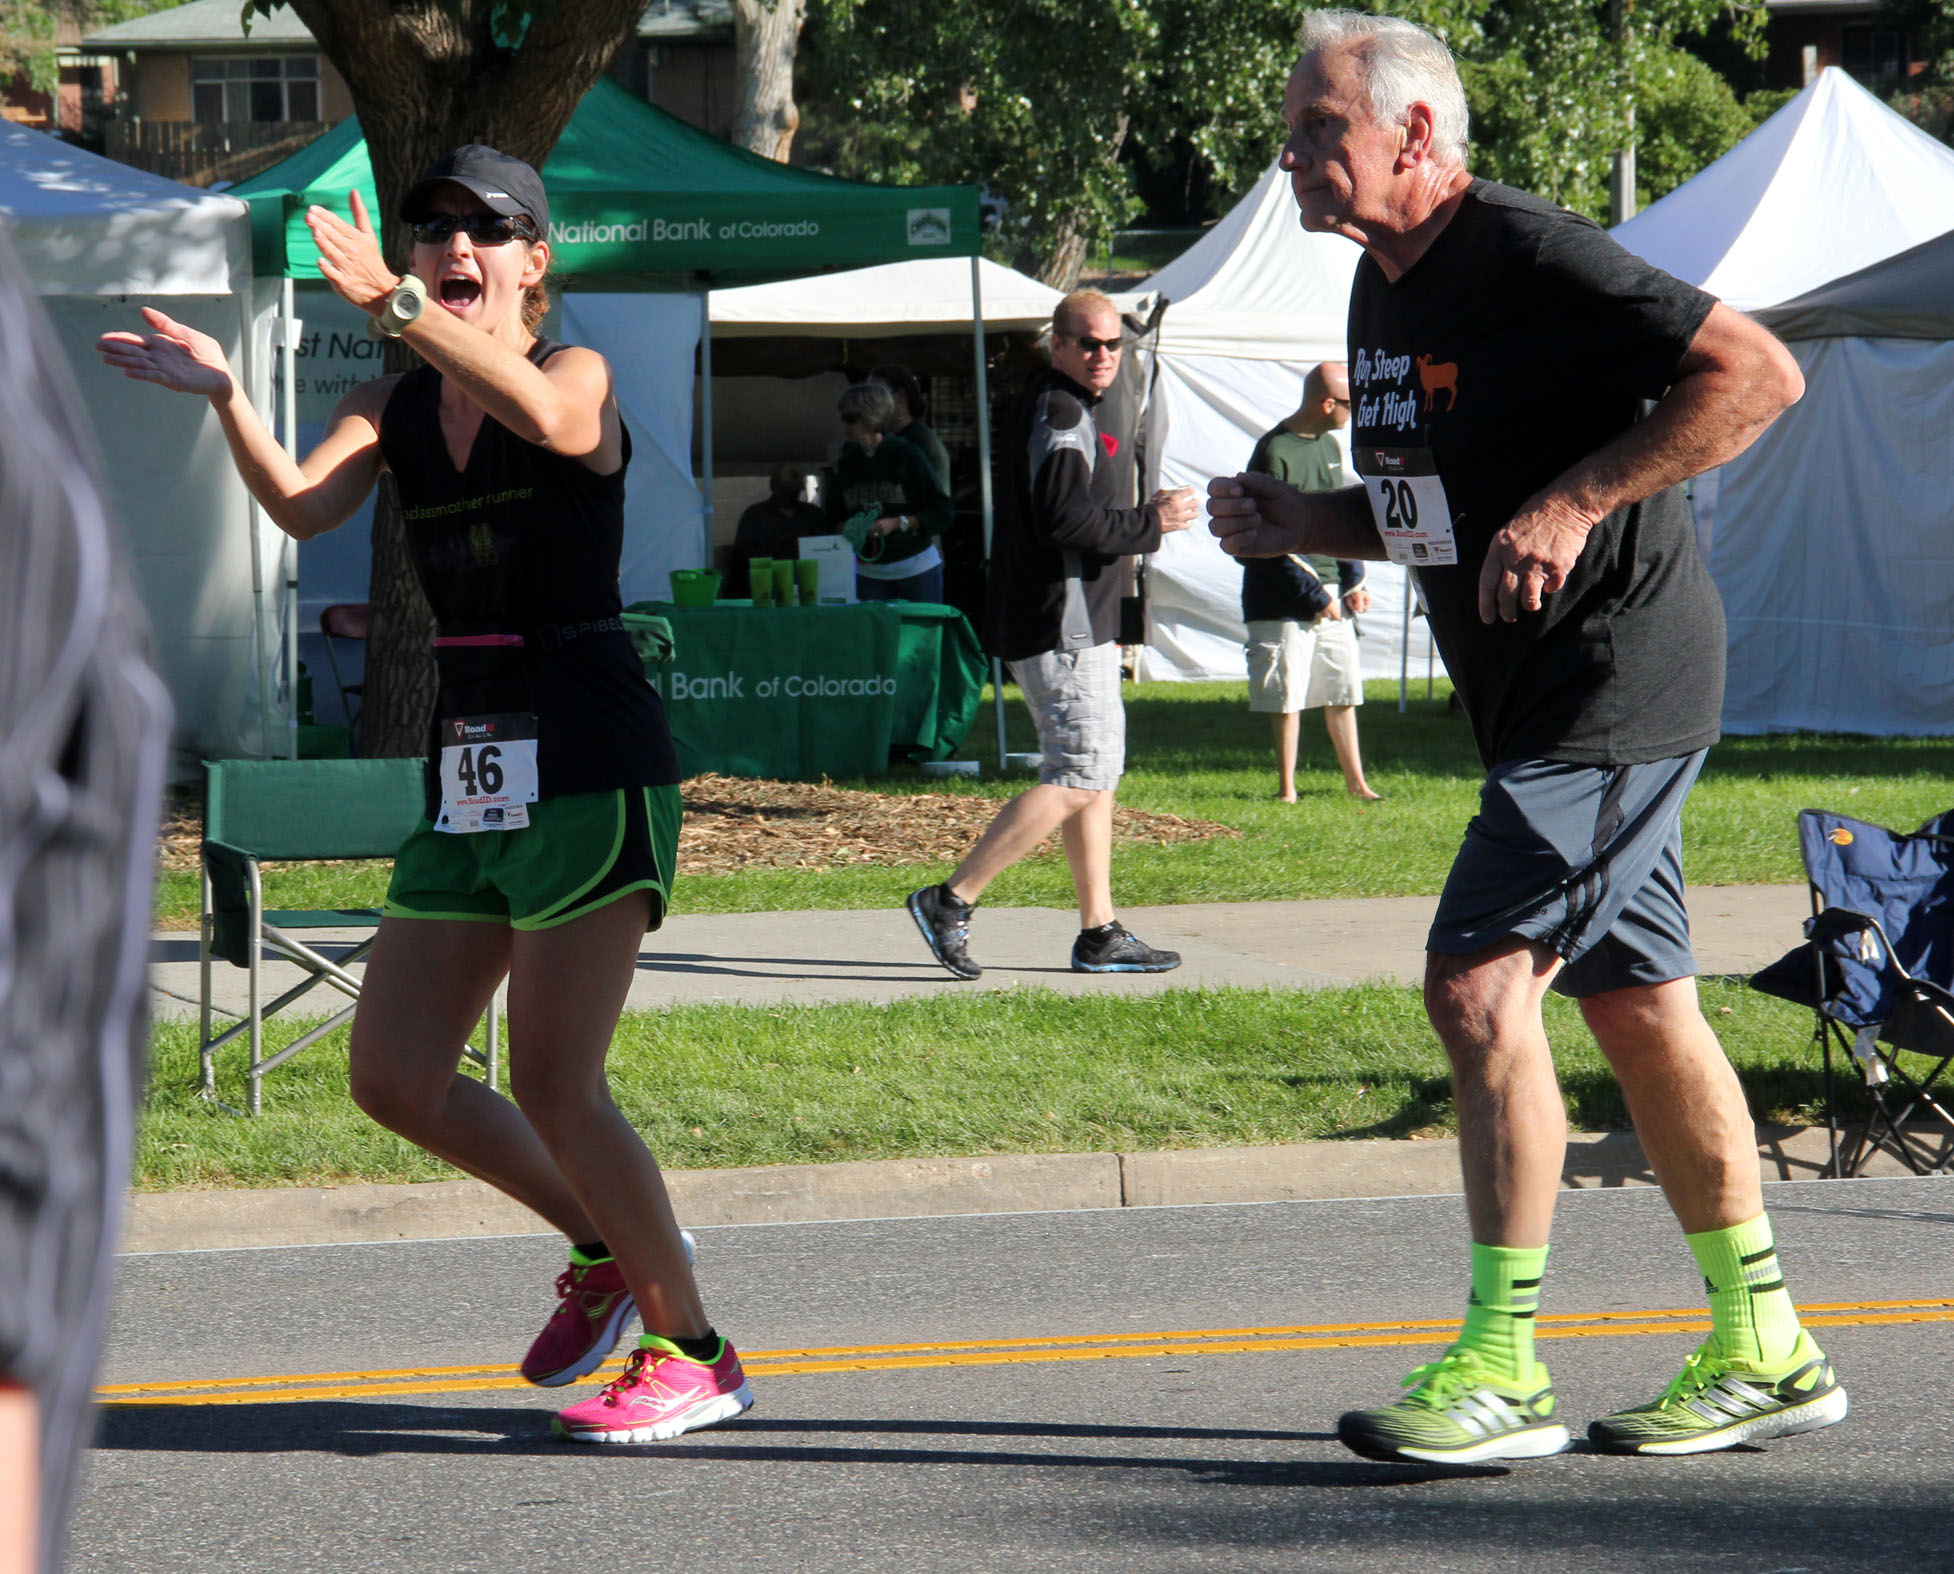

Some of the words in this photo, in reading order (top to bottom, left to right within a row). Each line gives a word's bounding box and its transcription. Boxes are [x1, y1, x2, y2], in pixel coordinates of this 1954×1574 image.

[547, 219, 648, 244] National
[653, 217, 712, 241] Bank
[719, 223, 736, 240] of
[739, 219, 820, 239] Colorado
[1353, 347, 1372, 389] Run
[1371, 348, 1411, 386] Steep
[1357, 393, 1381, 429] Get
[1381, 389, 1417, 432] High
[486, 487, 535, 505] runner
[1381, 478, 1418, 530] 20
[670, 670, 745, 701] Bank
[755, 676, 781, 698] of
[783, 674, 897, 697] Colorado
[458, 744, 504, 796] 46
